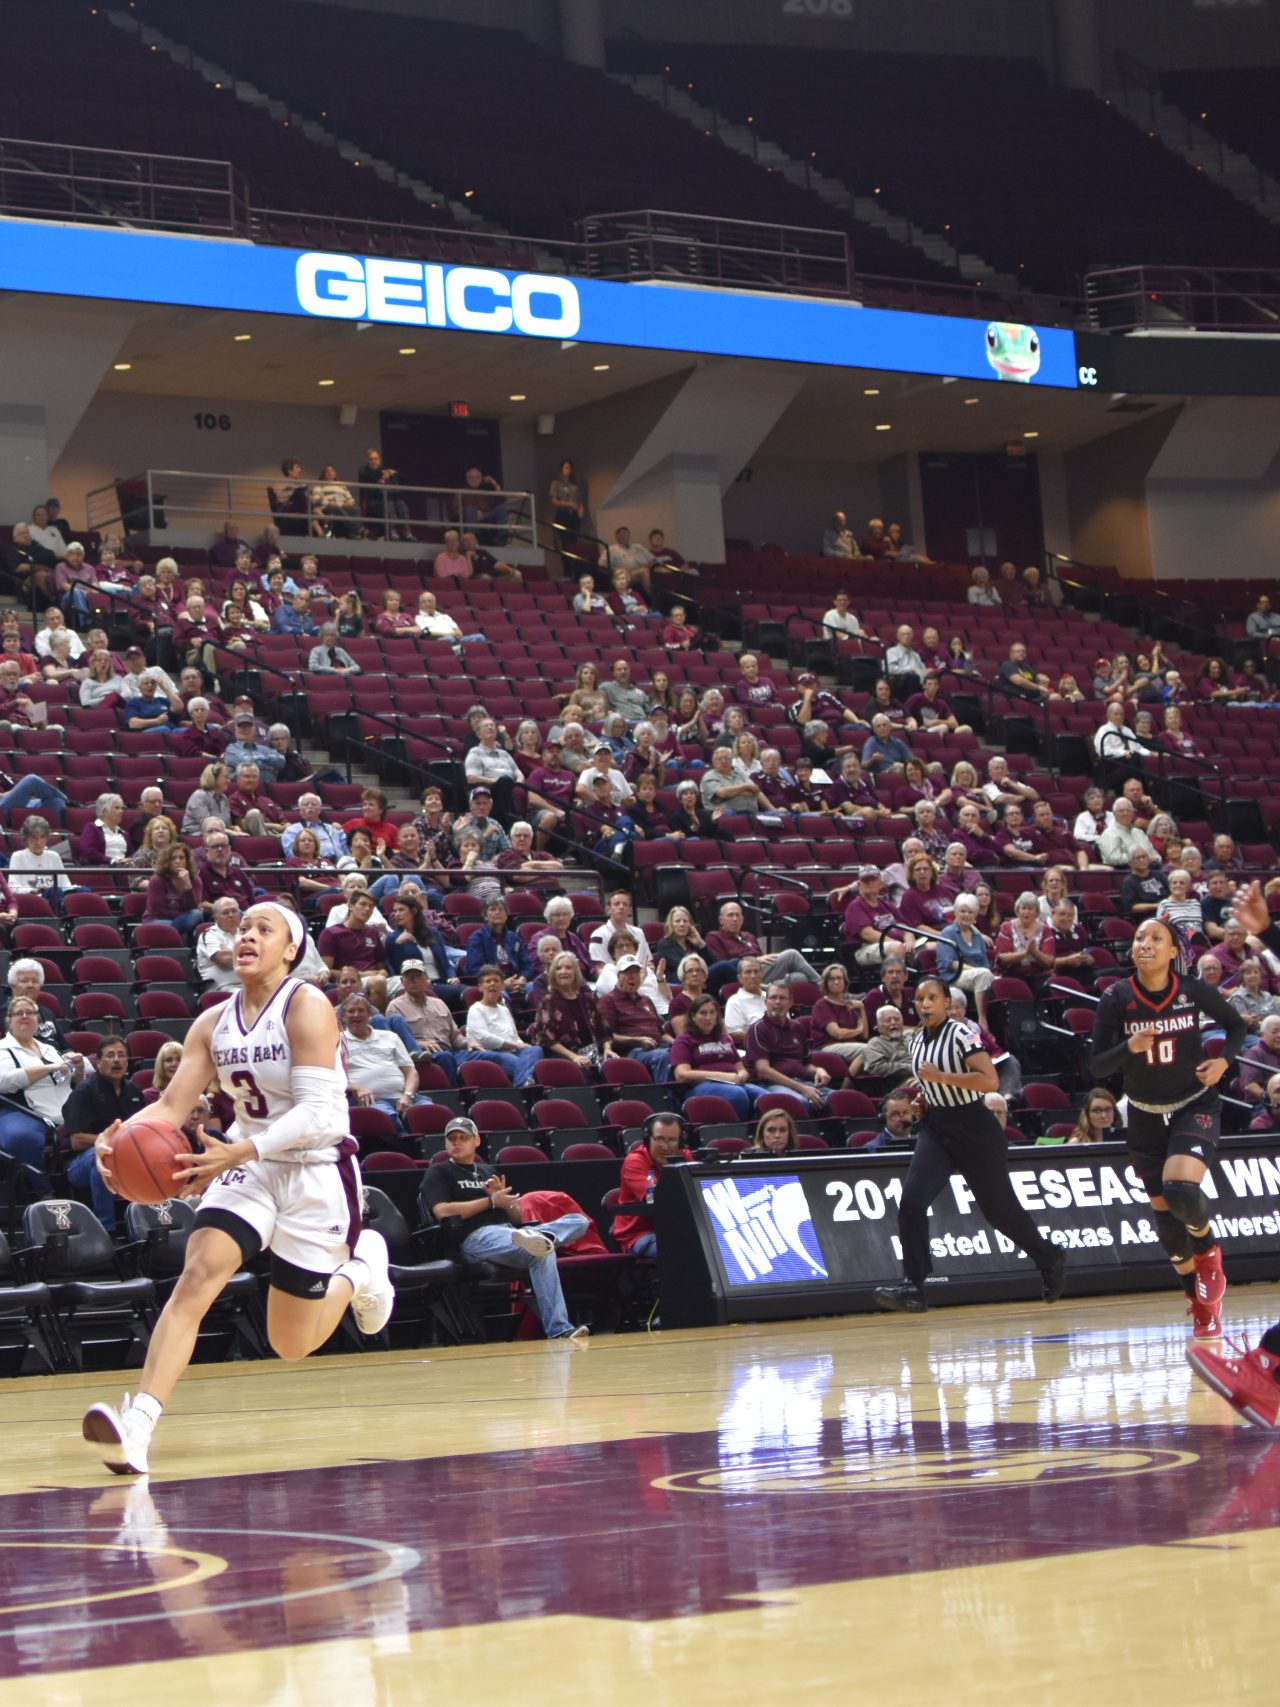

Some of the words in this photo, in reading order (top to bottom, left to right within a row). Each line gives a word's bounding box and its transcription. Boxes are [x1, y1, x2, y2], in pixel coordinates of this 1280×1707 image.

[295, 252, 581, 338] GEICO
[1079, 366, 1098, 385] CC
[193, 412, 231, 431] 106
[253, 1043, 287, 1063] A&M
[1145, 1040, 1174, 1064] 10
[231, 1070, 269, 1118] 3
[826, 1178, 933, 1222] 201
